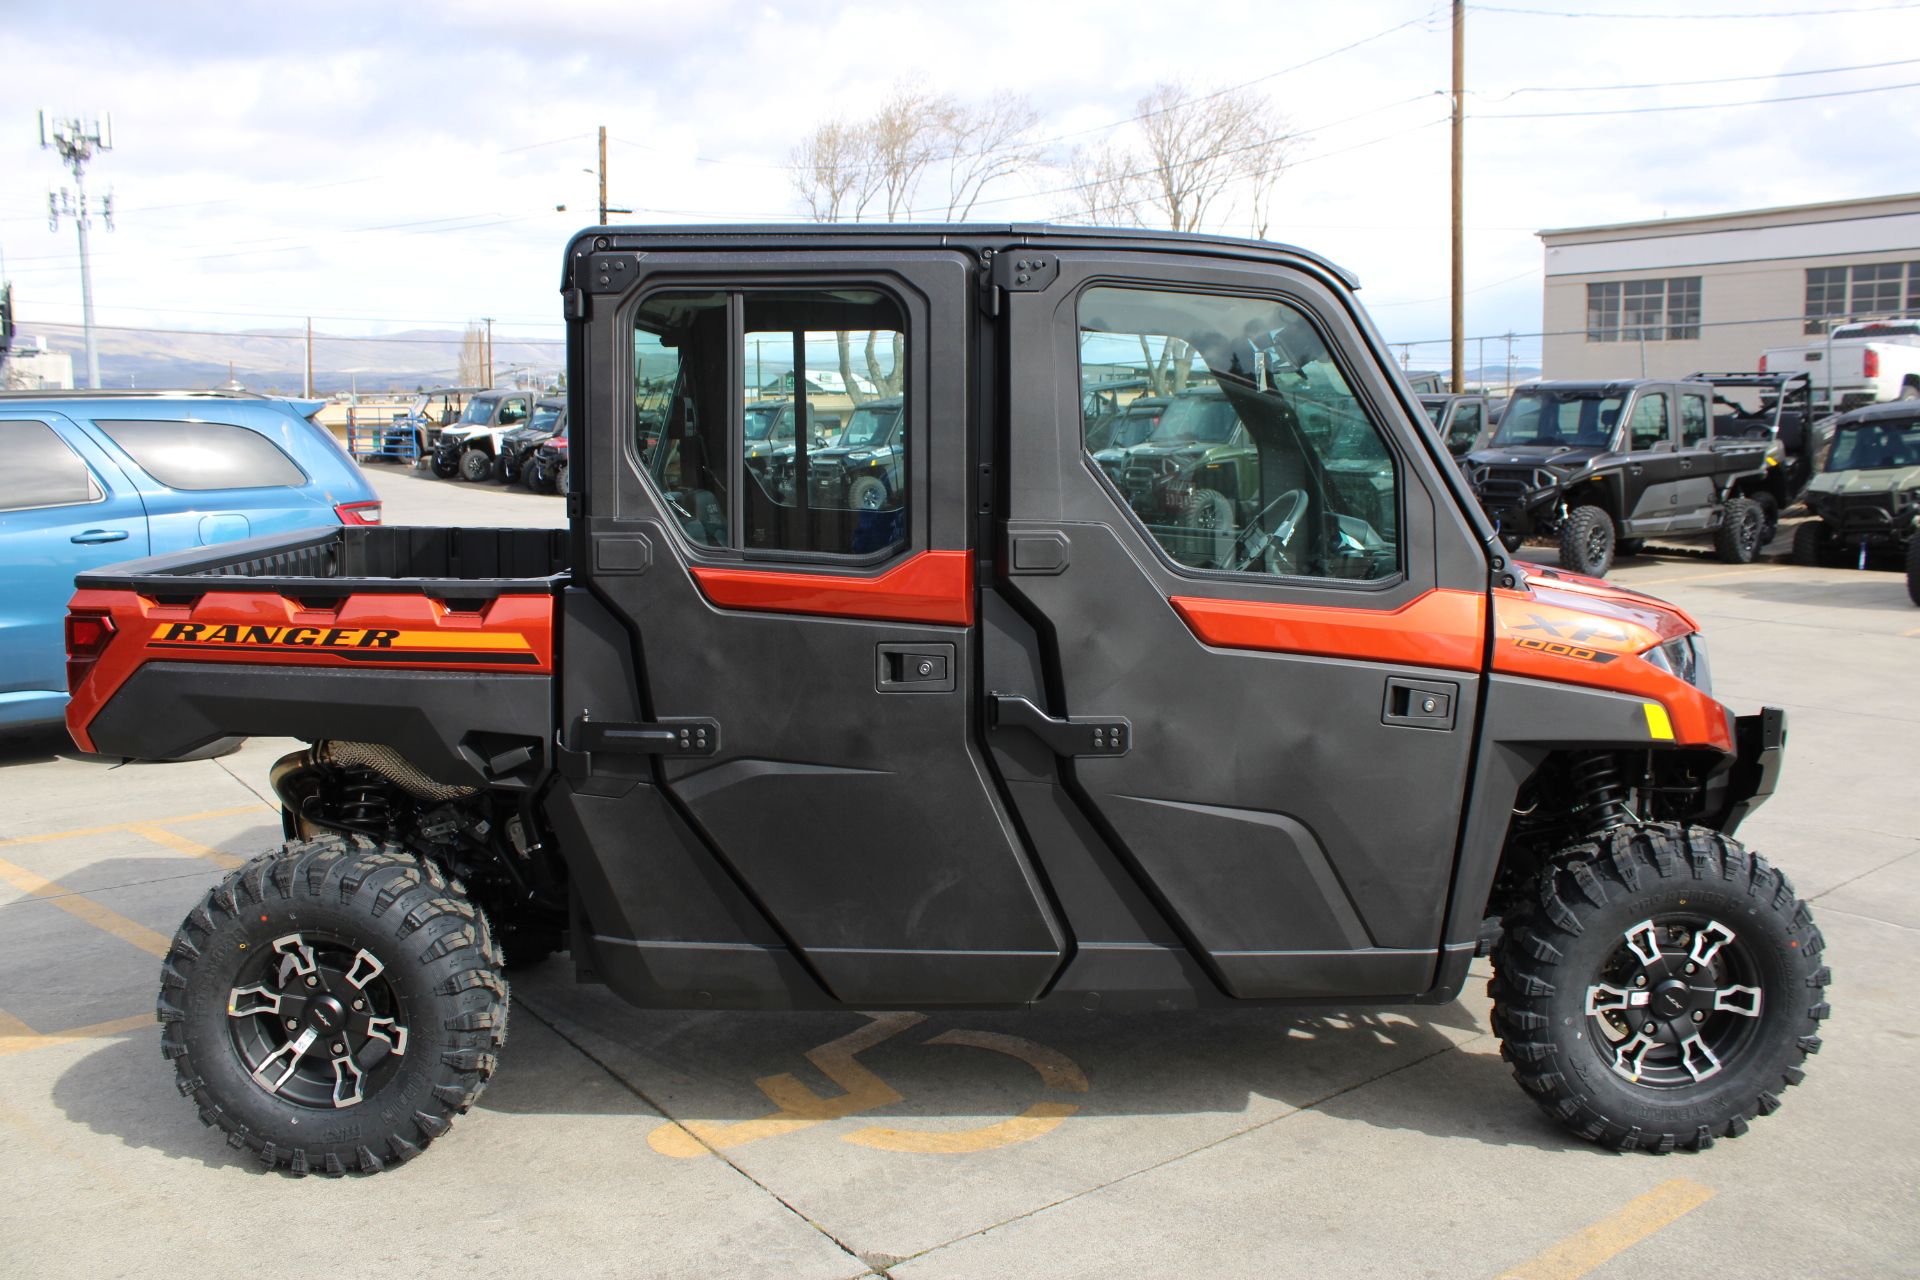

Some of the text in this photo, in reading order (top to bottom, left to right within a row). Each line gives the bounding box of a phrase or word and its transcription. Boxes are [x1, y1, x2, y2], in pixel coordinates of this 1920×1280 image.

[162, 622, 401, 648] RANGER
[1511, 613, 1629, 642] XP
[1511, 635, 1597, 661] 1000
